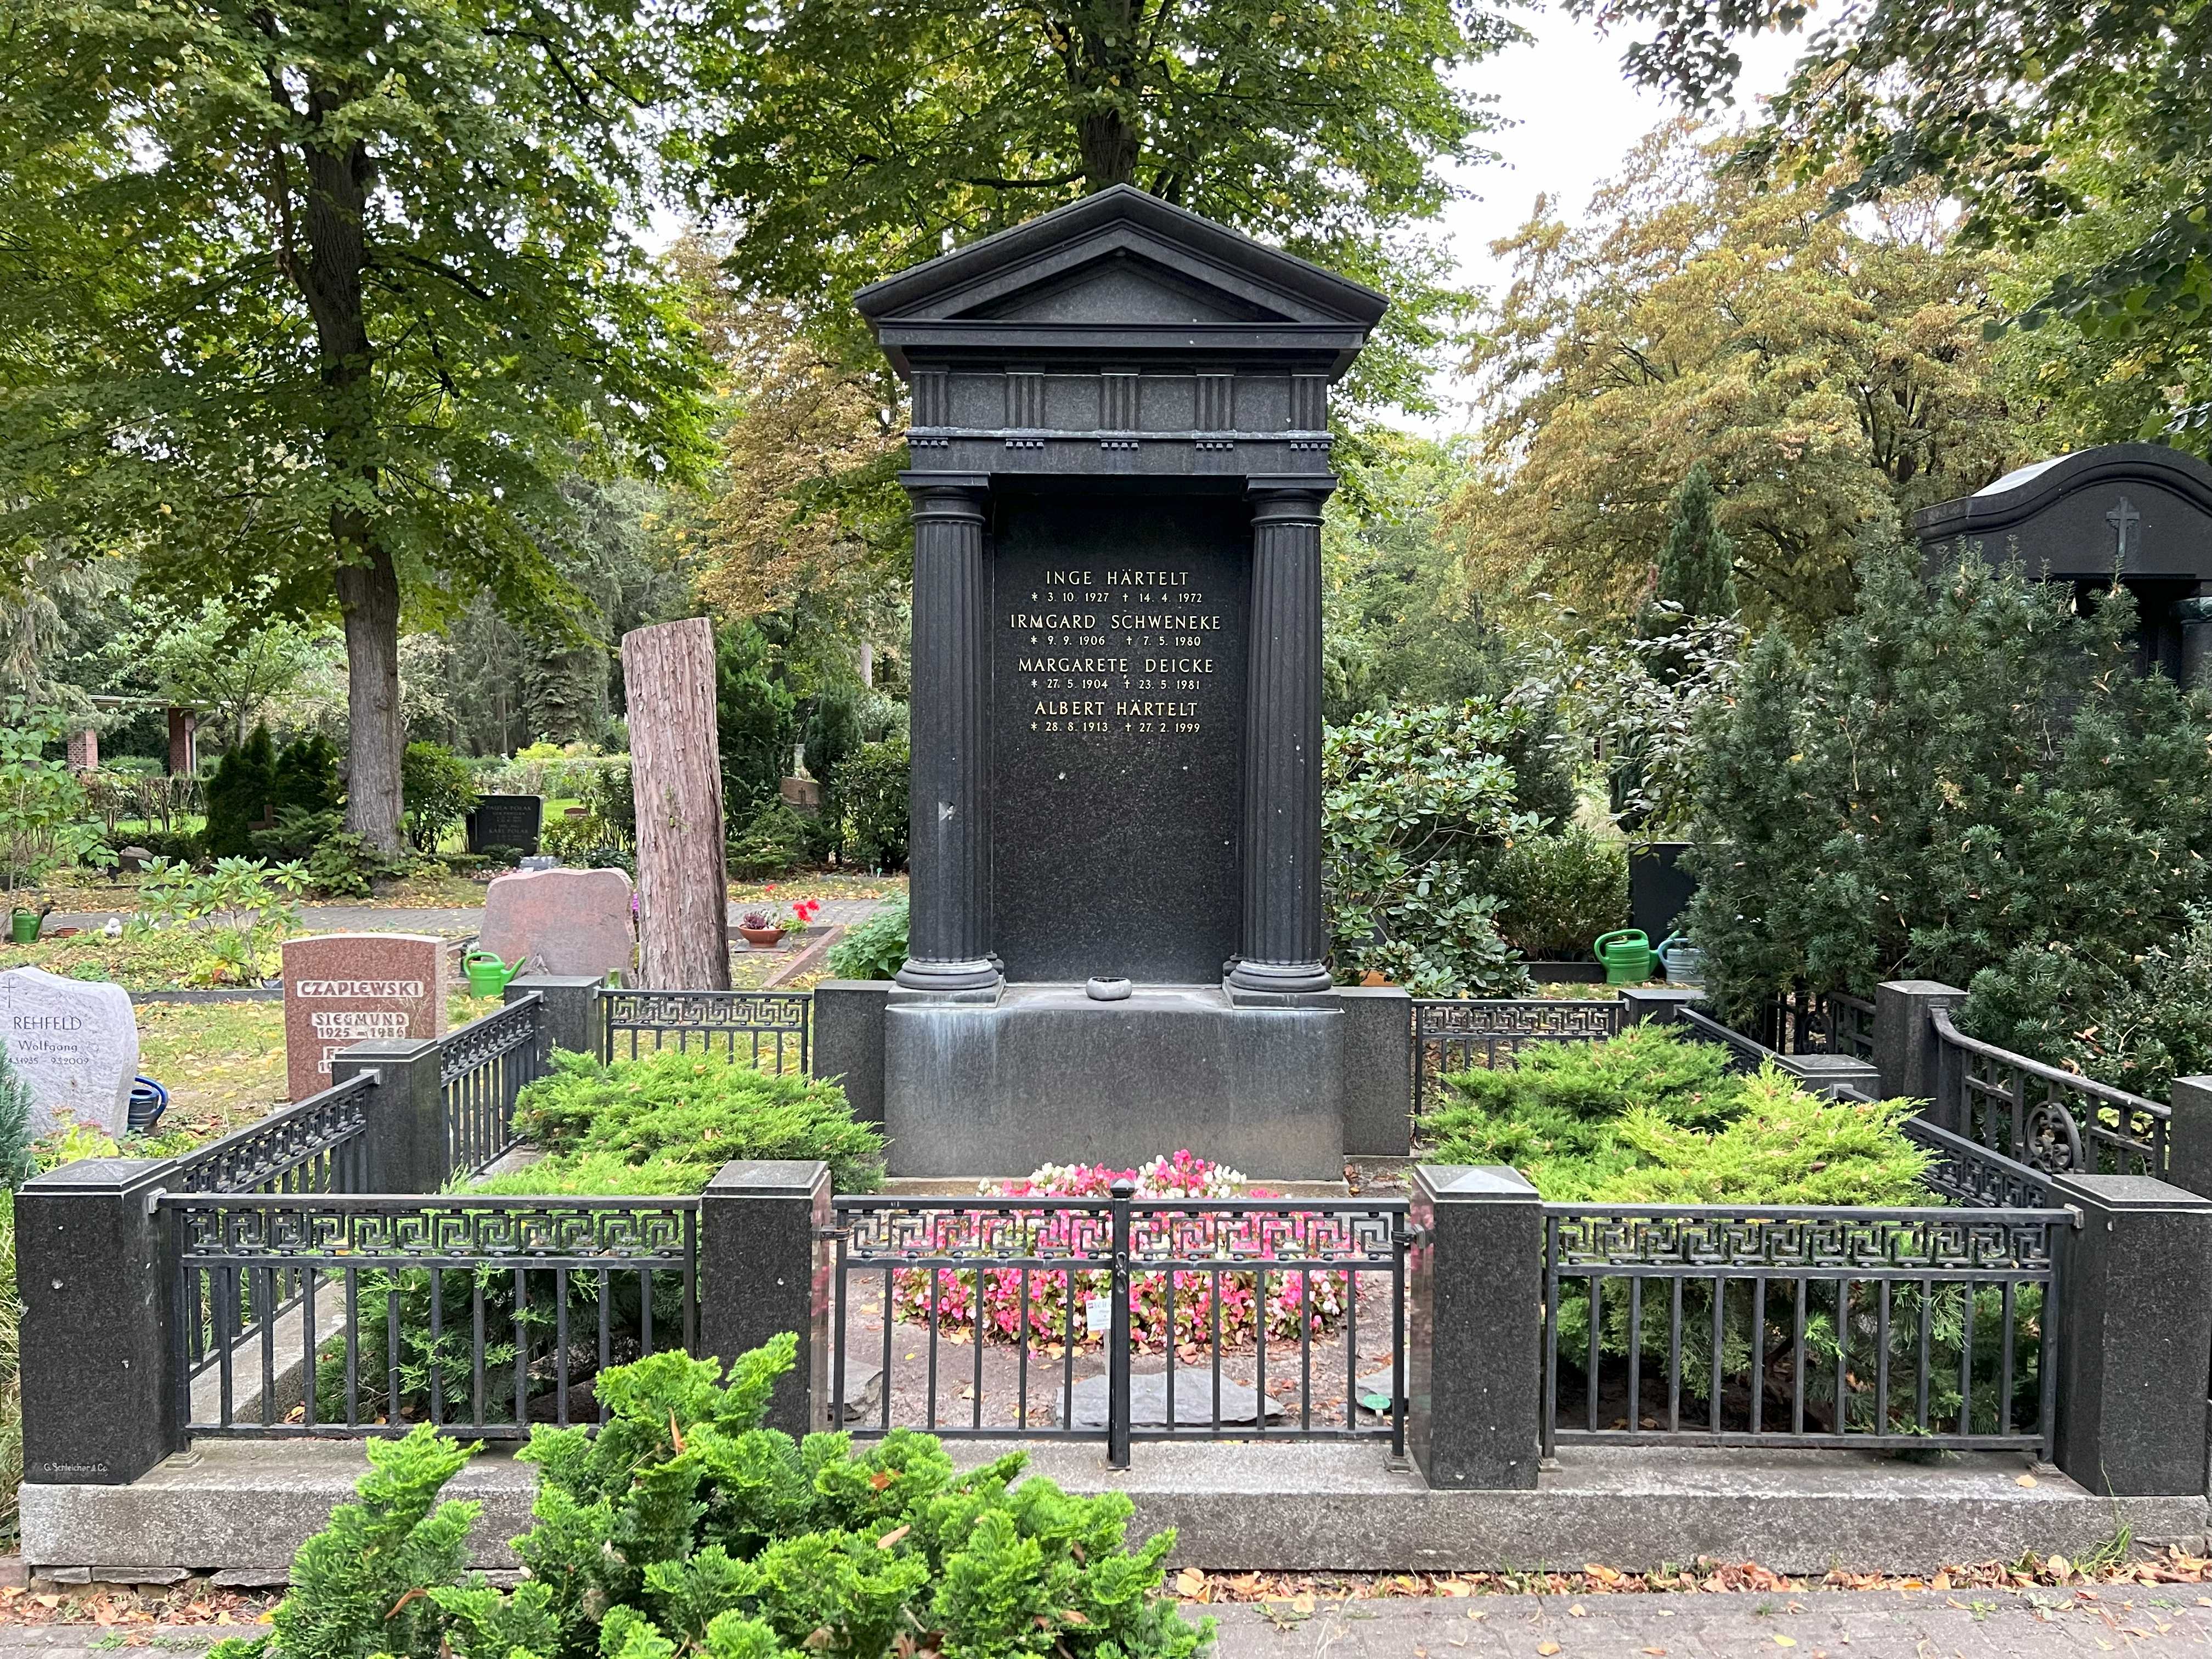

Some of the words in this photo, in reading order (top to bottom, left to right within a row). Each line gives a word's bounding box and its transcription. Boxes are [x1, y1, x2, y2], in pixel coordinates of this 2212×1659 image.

[1046, 570, 1092, 585] INGE
[1107, 568, 1189, 586] HÄRTELT
[1047, 592, 1057, 602] 3.
[1063, 592, 1078, 602] 10.
[1085, 592, 1110, 603] 1927
[1139, 592, 1154, 603] 14.
[1161, 592, 1171, 603] 4.
[1179, 593, 1203, 603] 1972
[1011, 613, 1096, 629] IRMGARD
[1110, 614, 1221, 630] SCHWENEKE
[1047, 635, 1057, 646] 9.
[1063, 635, 1073, 646] 9.
[1079, 635, 1105, 646] 1906
[1143, 636, 1152, 646] 7.
[1159, 636, 1168, 646] 5.
[1175, 636, 1201, 647] 1980
[1018, 657, 1129, 673] MARGARETE
[1144, 658, 1214, 673] DEICKE
[1047, 678, 1060, 689] 27.
[1067, 679, 1077, 689] 5.
[1082, 679, 1108, 689] 1904
[1138, 679, 1155, 690] 23.
[1160, 679, 1171, 690] 5.
[1176, 680, 1200, 690] 1981
[1034, 700, 1105, 716] ALBERT
[1116, 698, 1198, 716] HÄRTELT
[1045, 721, 1063, 732] 28.
[1067, 721, 1078, 732] 8.
[1083, 721, 1109, 732] 1913
[1139, 723, 1154, 733] 27.
[1159, 723, 1170, 733] 2.
[1175, 723, 1201, 733] 1999
[301, 981, 419, 996] CZAPLEWSKI
[13, 1015, 82, 1030] REHFELD
[315, 1013, 405, 1026] SIEGMUND
[319, 1027, 350, 1038] 1925
[369, 1027, 404, 1038] 1986
[18, 1040, 78, 1053] Wolfgang
[52, 1462, 91, 1471] Schleicher
